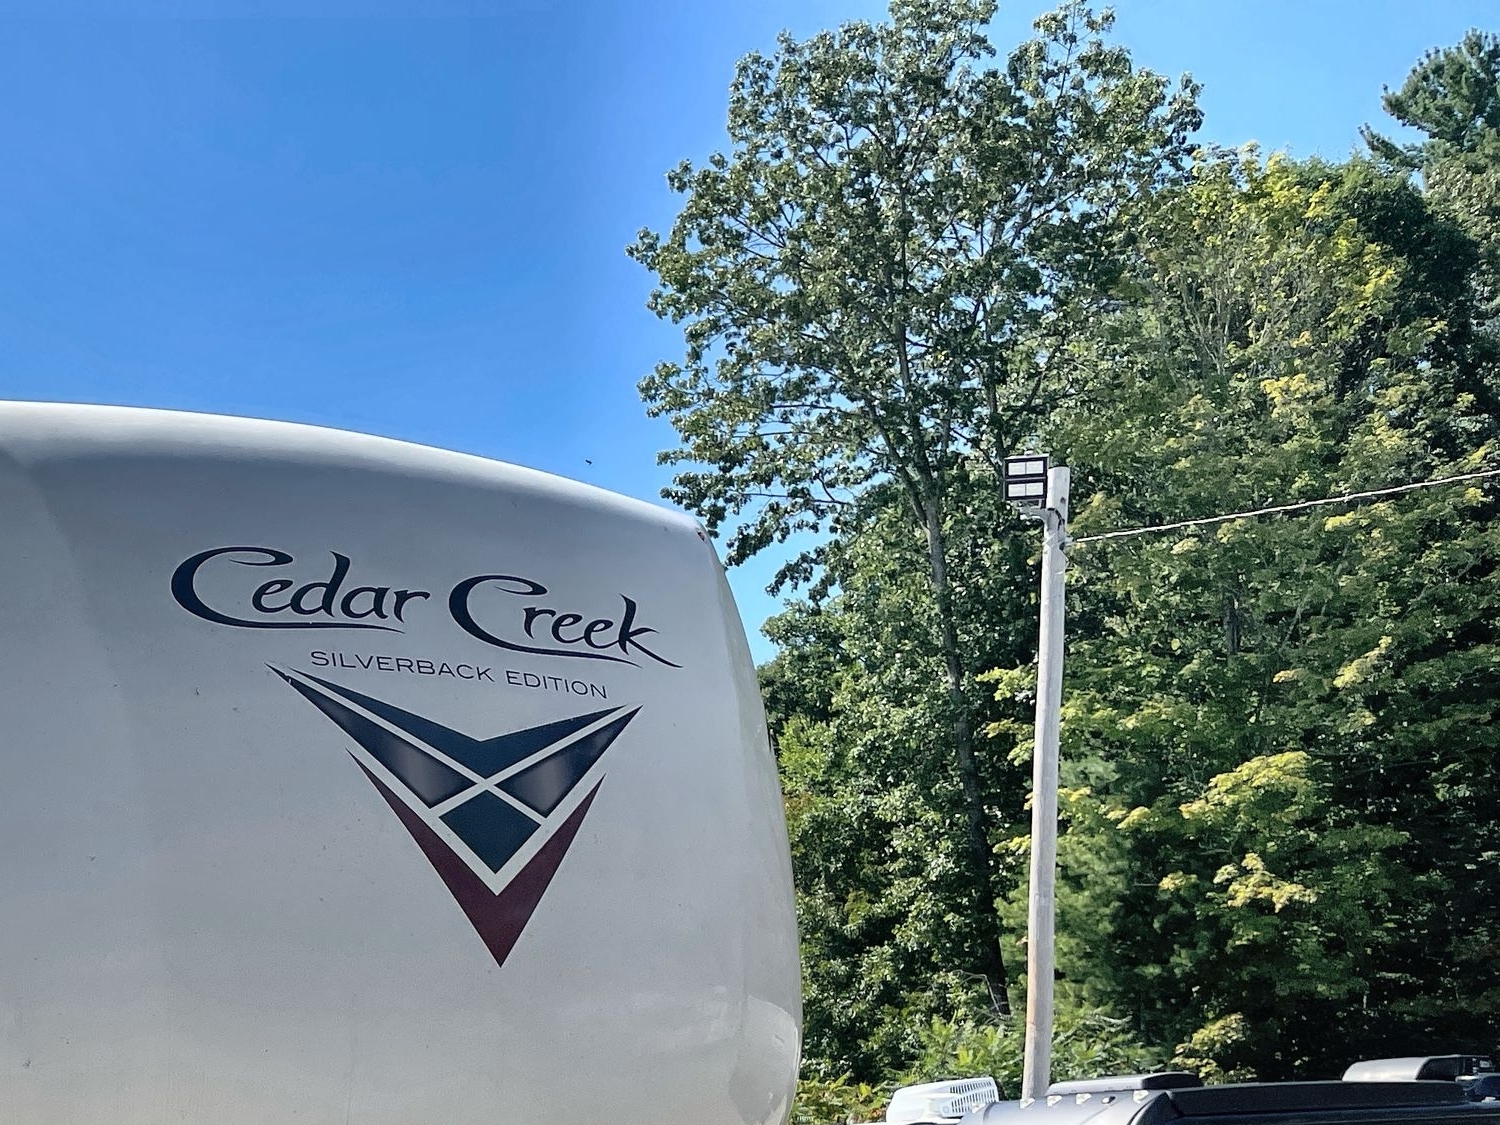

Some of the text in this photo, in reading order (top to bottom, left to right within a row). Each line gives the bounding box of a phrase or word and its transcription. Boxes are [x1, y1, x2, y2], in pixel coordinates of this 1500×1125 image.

[170, 546, 682, 669] Cedar Creek
[310, 650, 607, 699] SILVERBACK EDITION
